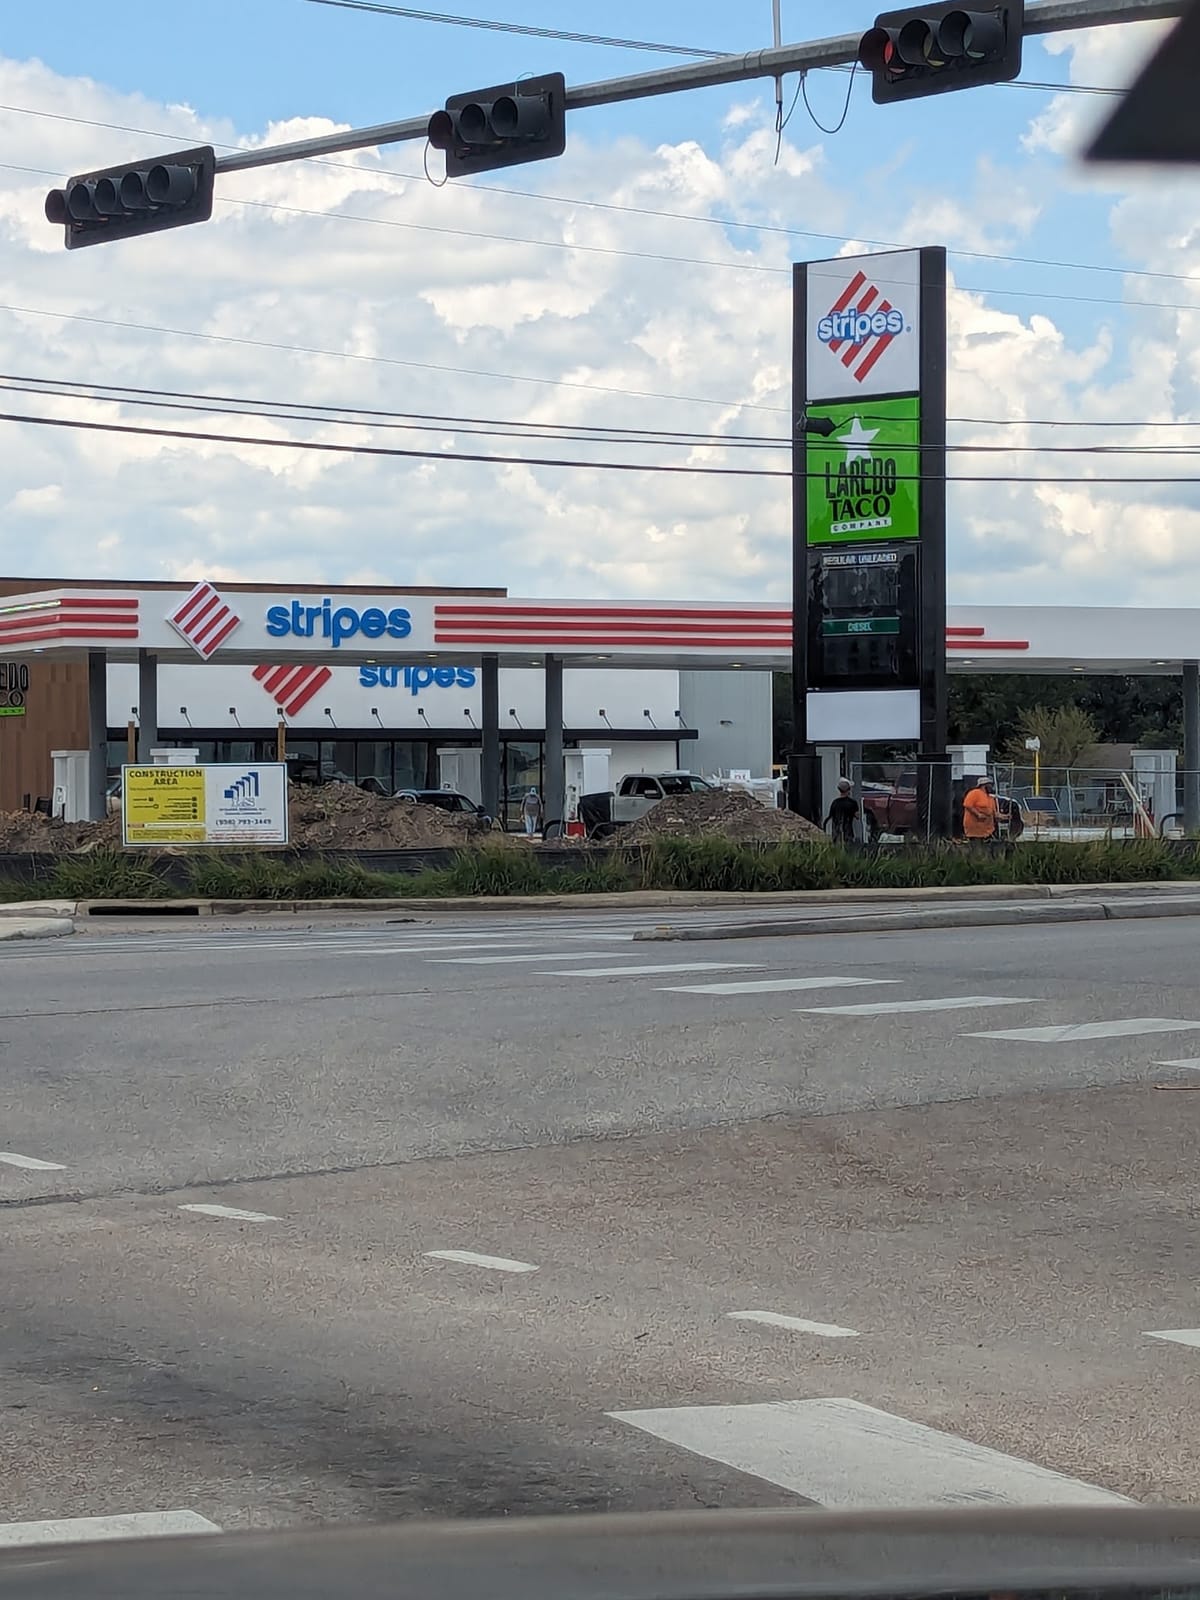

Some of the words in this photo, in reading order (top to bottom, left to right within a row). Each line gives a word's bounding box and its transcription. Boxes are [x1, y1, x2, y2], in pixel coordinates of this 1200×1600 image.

[818, 308, 903, 343] stripes
[825, 457, 897, 499] LAREDO
[828, 495, 891, 522] TACO
[832, 518, 890, 533] COMPANY
[266, 598, 412, 648] stripes
[359, 665, 476, 696] stripes
[129, 769, 203, 778] CONSTRUCTION
[153, 777, 179, 786] AREA
